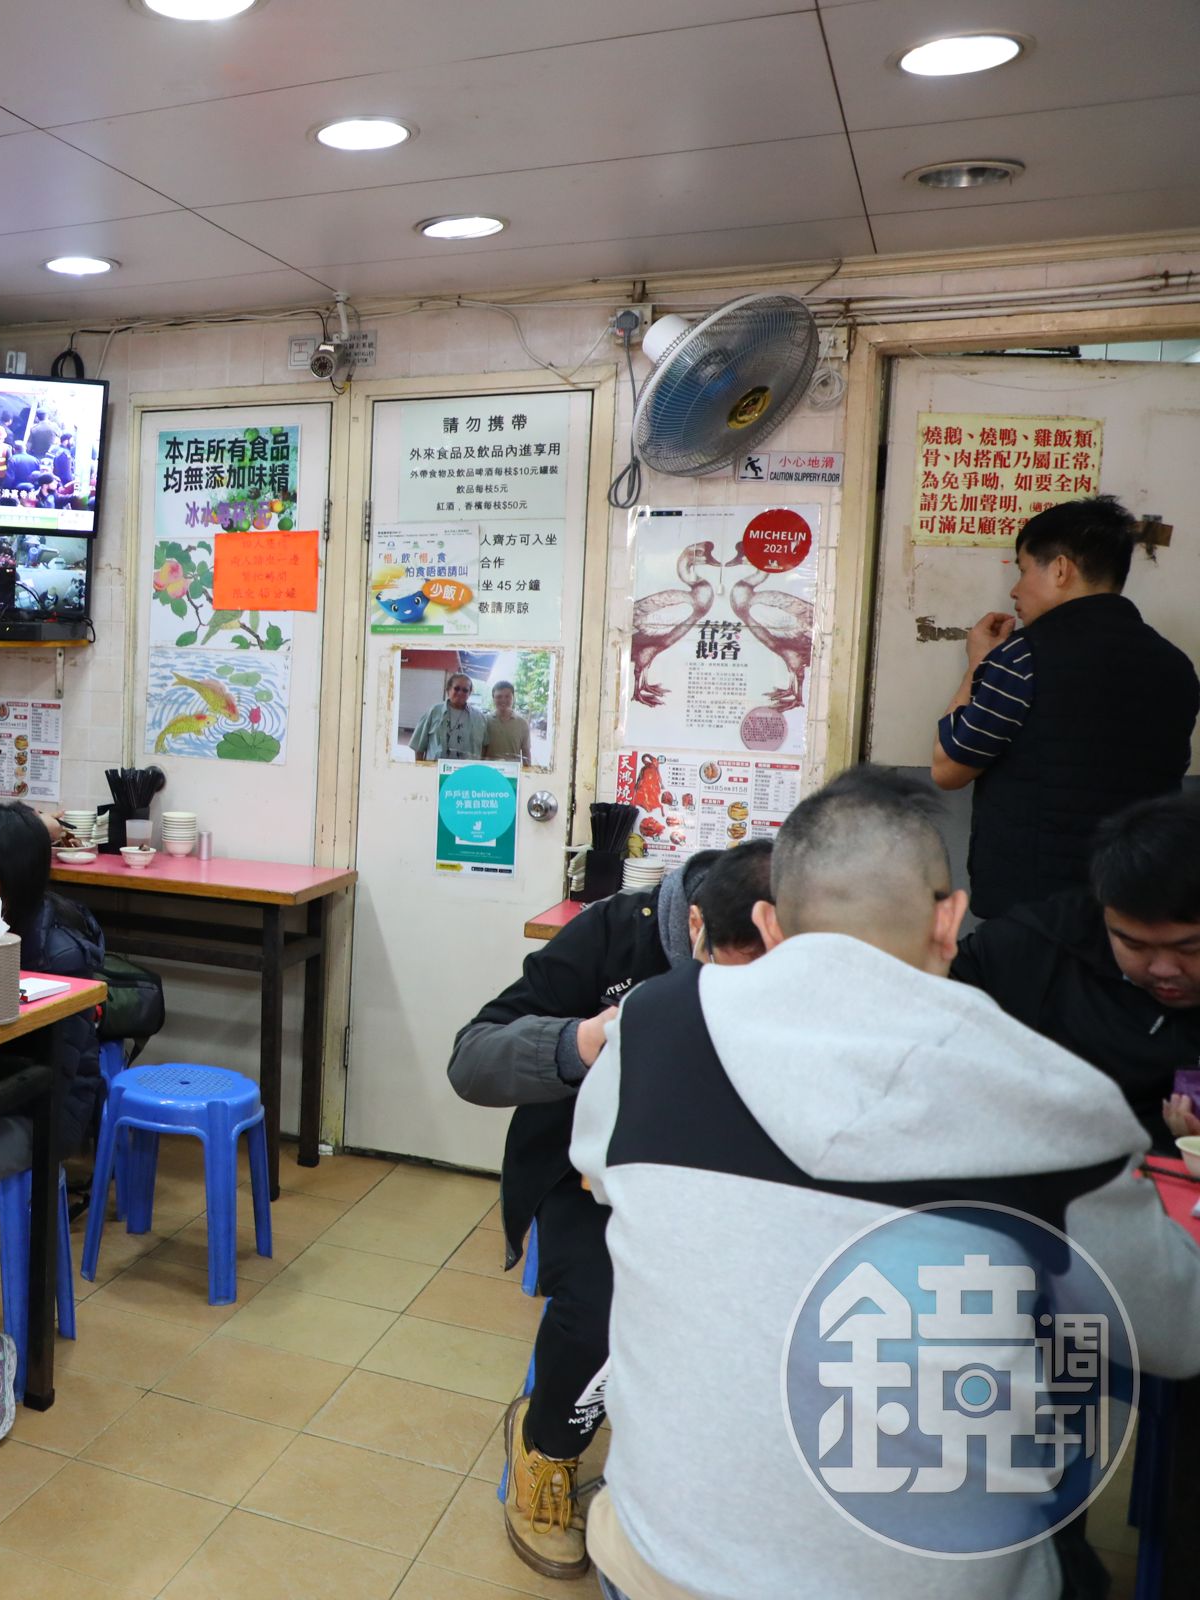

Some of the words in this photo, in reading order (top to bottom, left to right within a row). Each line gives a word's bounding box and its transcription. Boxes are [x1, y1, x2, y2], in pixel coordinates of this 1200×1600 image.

[165, 432, 290, 464] 本店所有食品
[409, 442, 561, 461] 外來食品及飲品內進享用
[780, 456, 835, 469] 小心地滑
[163, 464, 290, 494] 均無添加味精
[770, 472, 793, 481] CAUTION
[794, 472, 820, 482] SLIPPERY
[822, 473, 840, 482] FLOOR
[456, 484, 509, 494] 飲品每枝5元
[749, 530, 807, 541] MICHELIN
[764, 544, 788, 553] 2021
[480, 556, 505, 569] 合作
[497, 581, 511, 590] 45
[516, 579, 540, 591] 分鐘
[471, 790, 509, 798] Deliveroo
